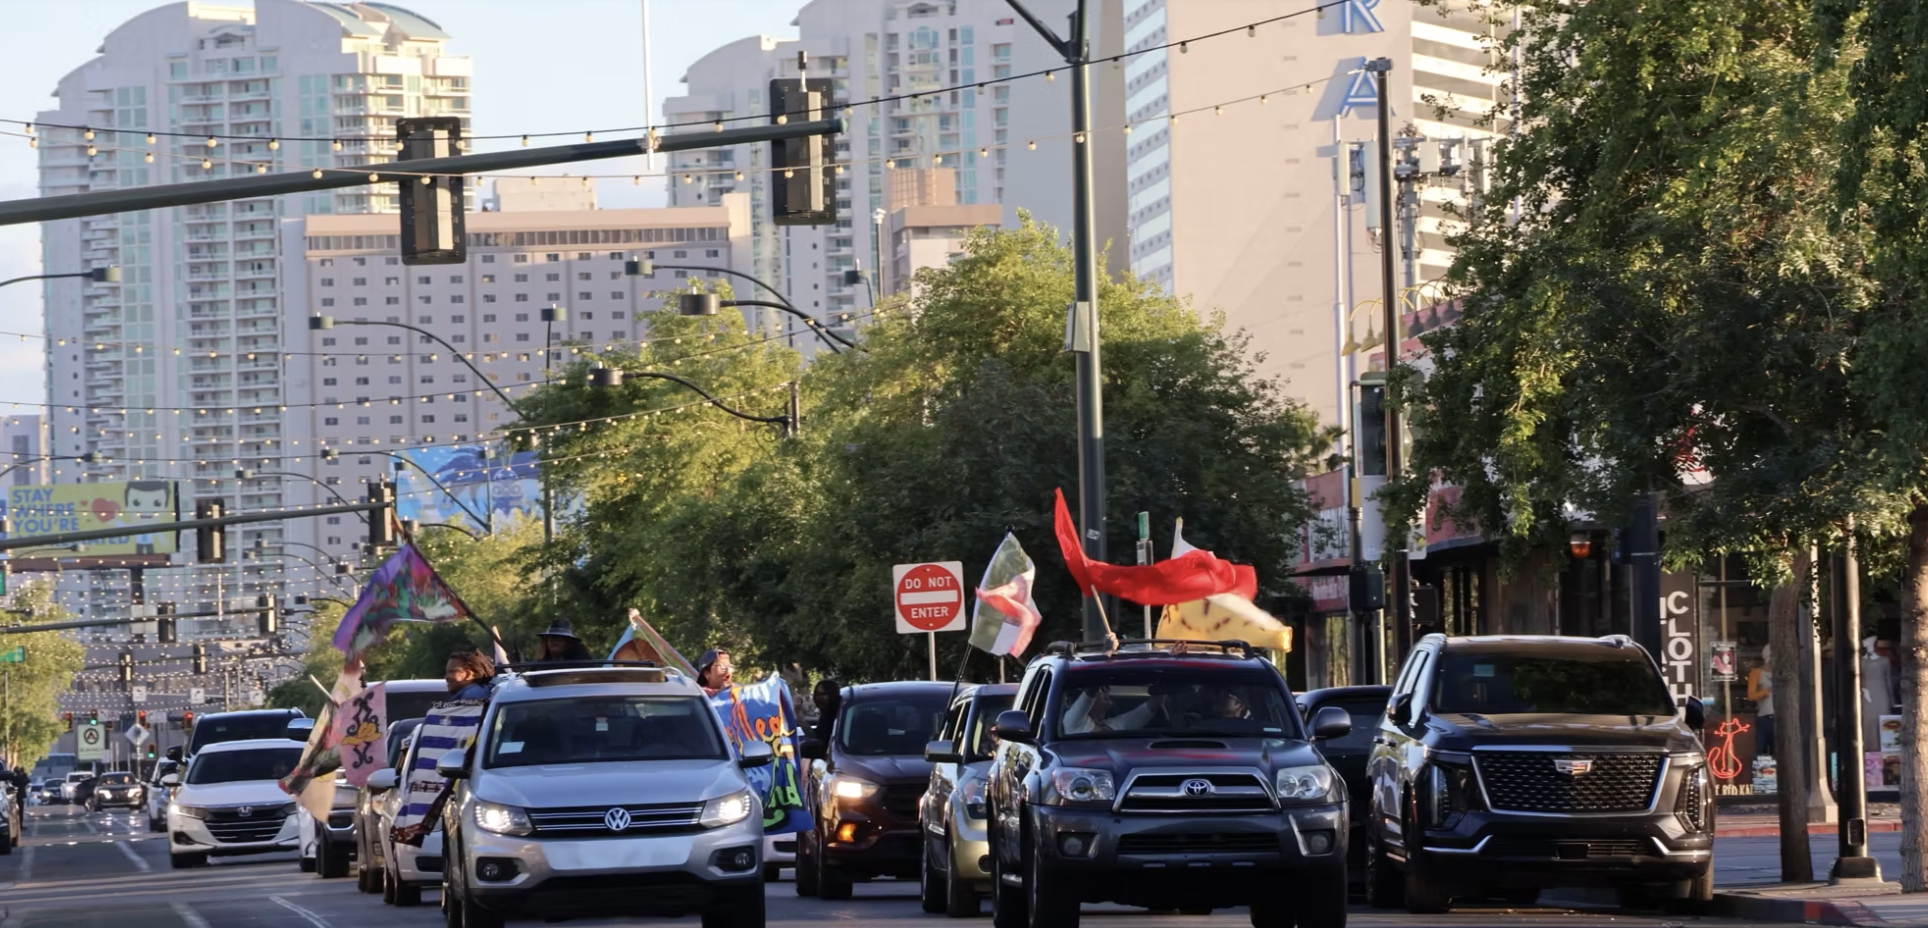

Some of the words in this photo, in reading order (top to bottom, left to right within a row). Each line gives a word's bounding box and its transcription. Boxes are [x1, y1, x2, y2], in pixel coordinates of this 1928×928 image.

[12, 488, 53, 503] STAY
[13, 502, 75, 518] WHERE
[13, 518, 79, 534] YOU'RE
[905, 578, 921, 589] DO
[928, 576, 952, 588] NOT
[911, 606, 949, 618] ENTER
